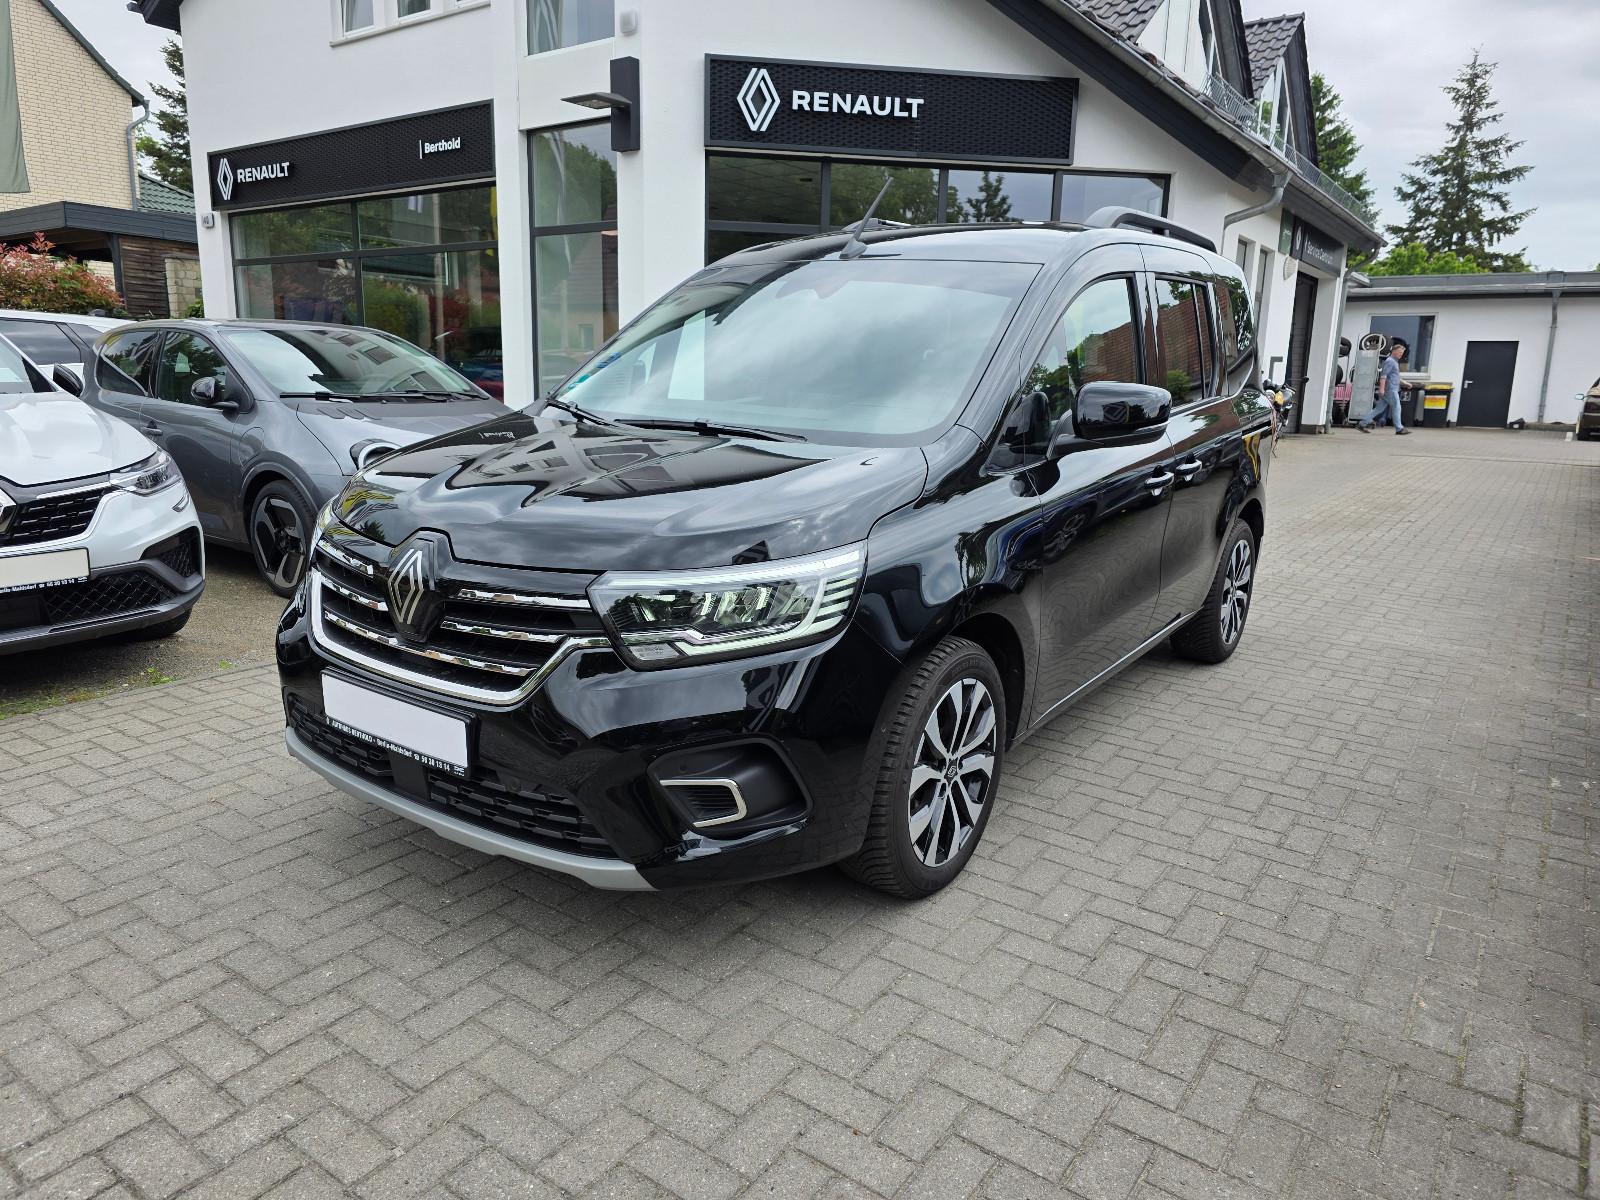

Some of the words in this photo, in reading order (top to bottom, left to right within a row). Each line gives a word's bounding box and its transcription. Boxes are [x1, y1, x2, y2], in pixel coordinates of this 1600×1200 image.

[791, 89, 925, 119] RENAULT
[424, 136, 461, 154] Berthold
[236, 161, 290, 183] RENAULT
